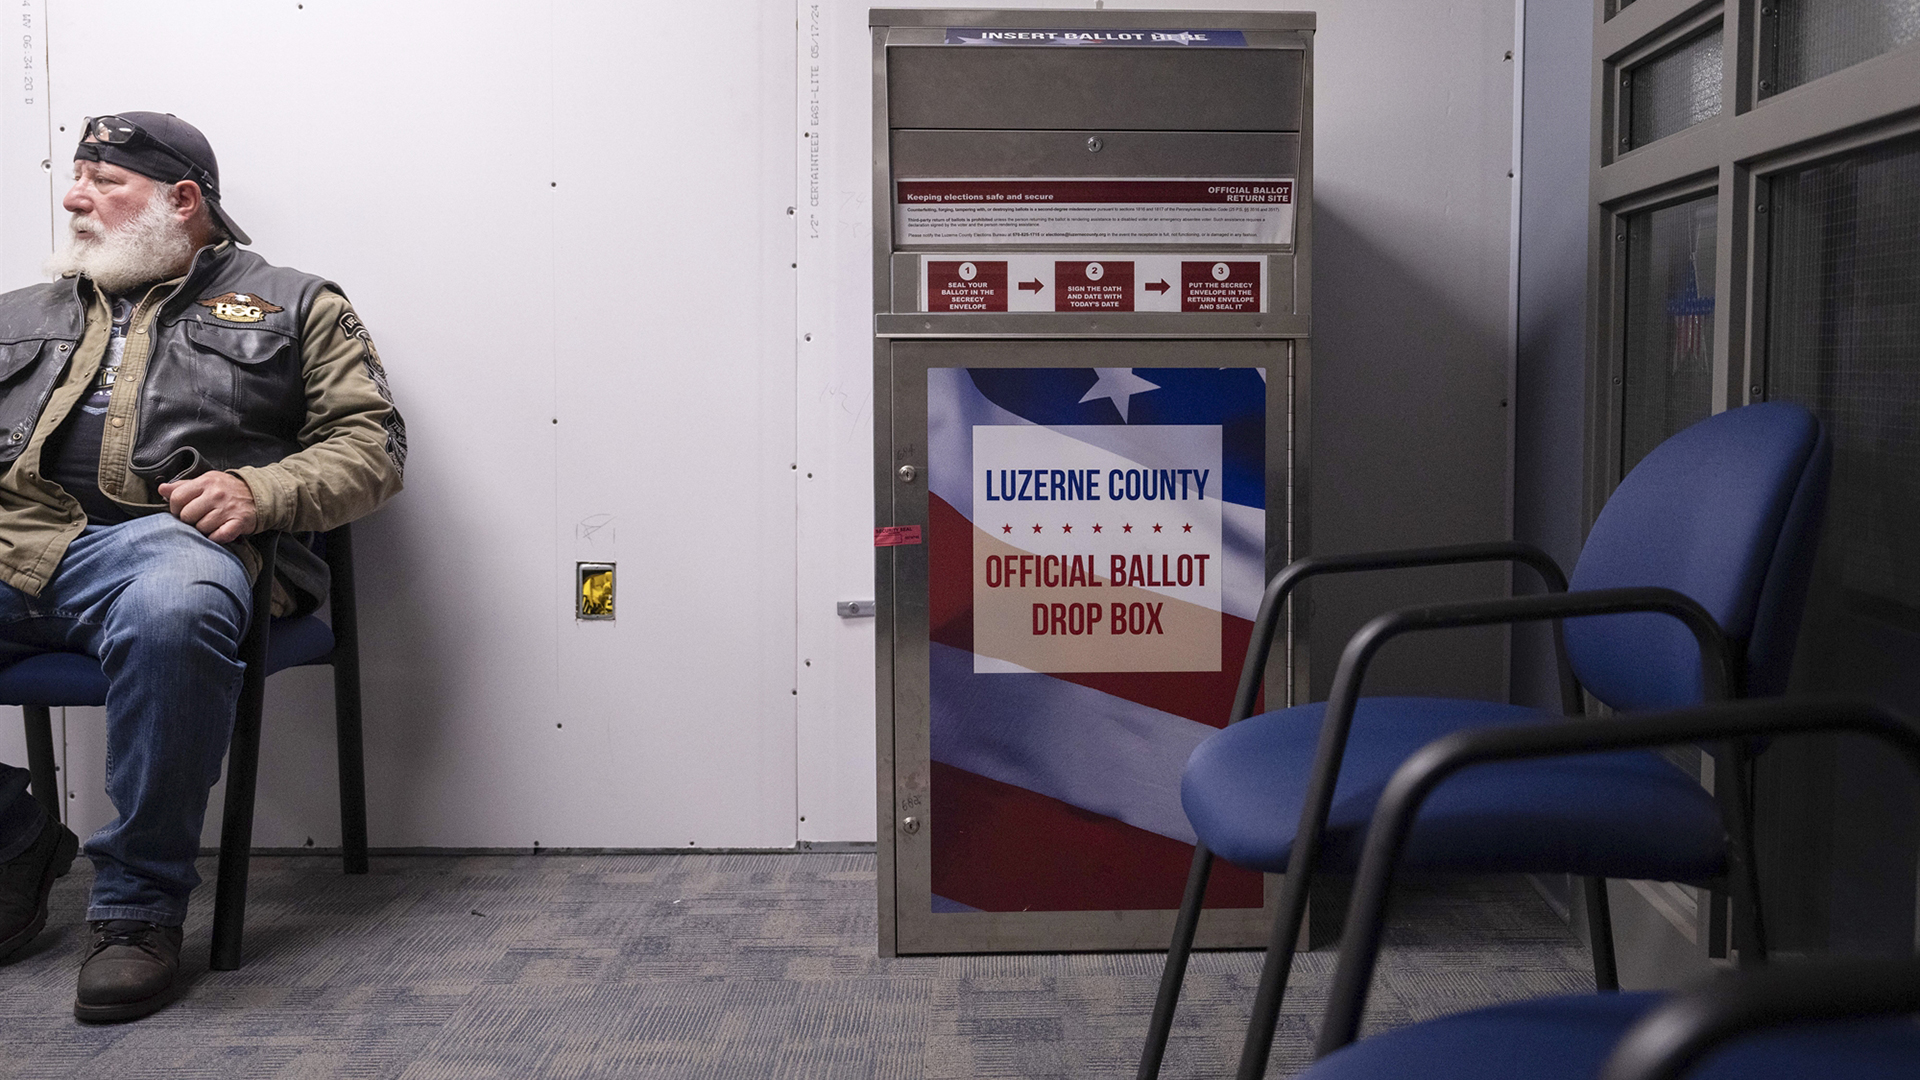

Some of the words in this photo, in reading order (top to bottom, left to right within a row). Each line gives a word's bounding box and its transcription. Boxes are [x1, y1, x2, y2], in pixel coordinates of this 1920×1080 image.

[811, 4, 819, 59] 05/17/24
[982, 32, 1058, 40] INSERT
[1064, 32, 1144, 41] BALLOT
[1151, 33, 1206, 41] HERE
[811, 65, 819, 126] EASI-LITE
[810, 132, 819, 207] CERTAINTEED
[216, 302, 261, 318] HOG
[986, 469, 1100, 501] LUZERNE
[1108, 468, 1210, 501] COUNTY
[986, 555, 1102, 588] OFFICIAL
[1110, 554, 1210, 586] BALLOT
[1032, 603, 1102, 635] DROP
[1111, 602, 1164, 635] BOX
